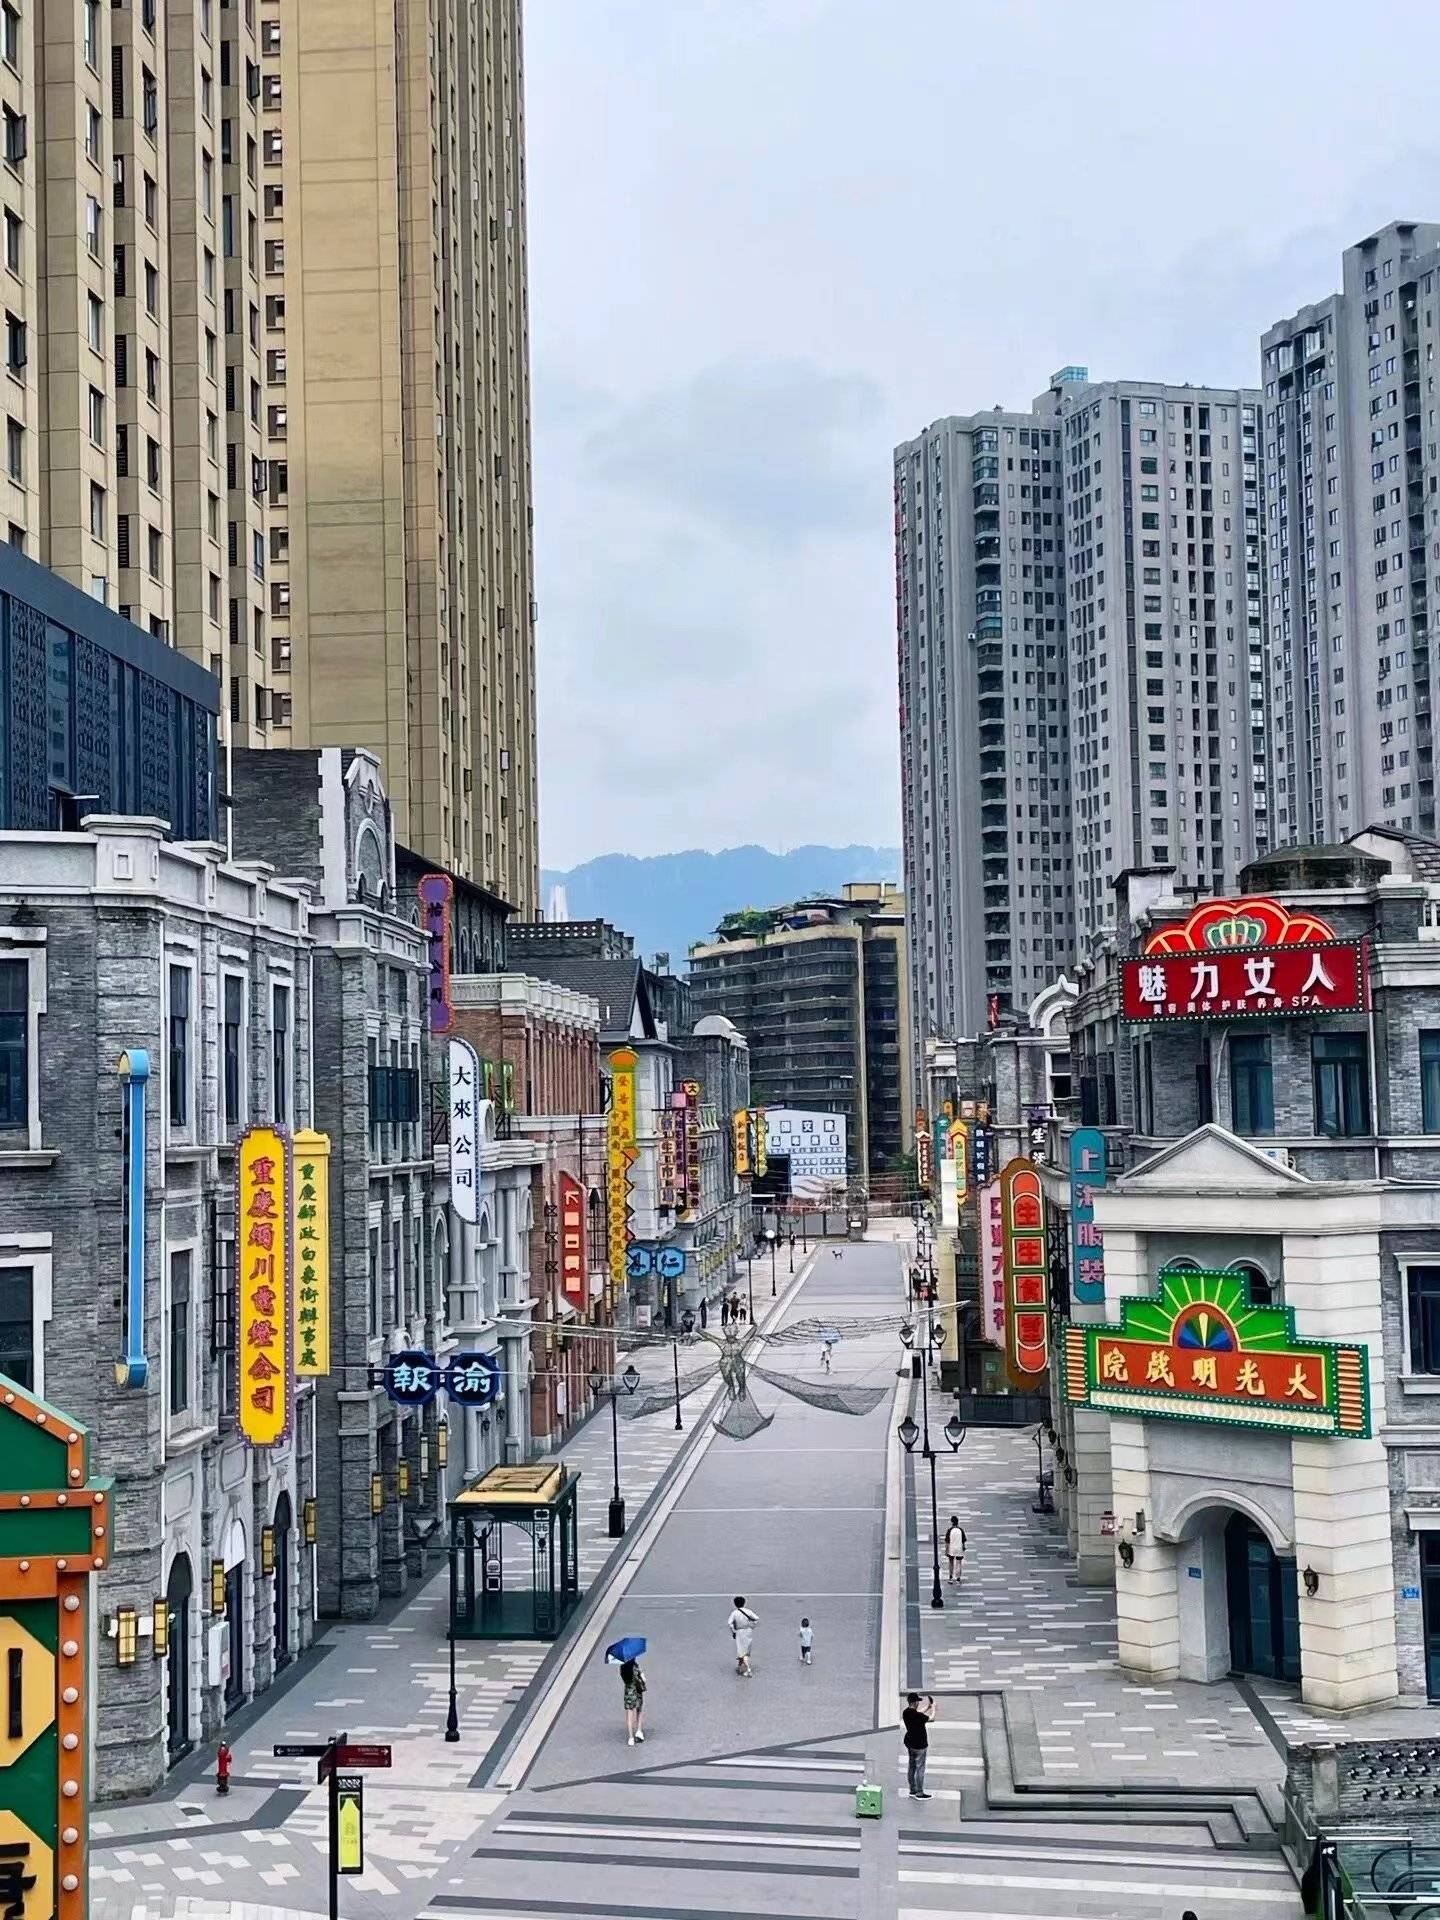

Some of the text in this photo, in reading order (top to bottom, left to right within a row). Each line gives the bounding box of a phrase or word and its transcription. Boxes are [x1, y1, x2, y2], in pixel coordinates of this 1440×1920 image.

[1138, 953, 1337, 1003] 魅力女人
[1292, 994, 1322, 1007] SPA
[452, 1066, 473, 1188] 大來公司
